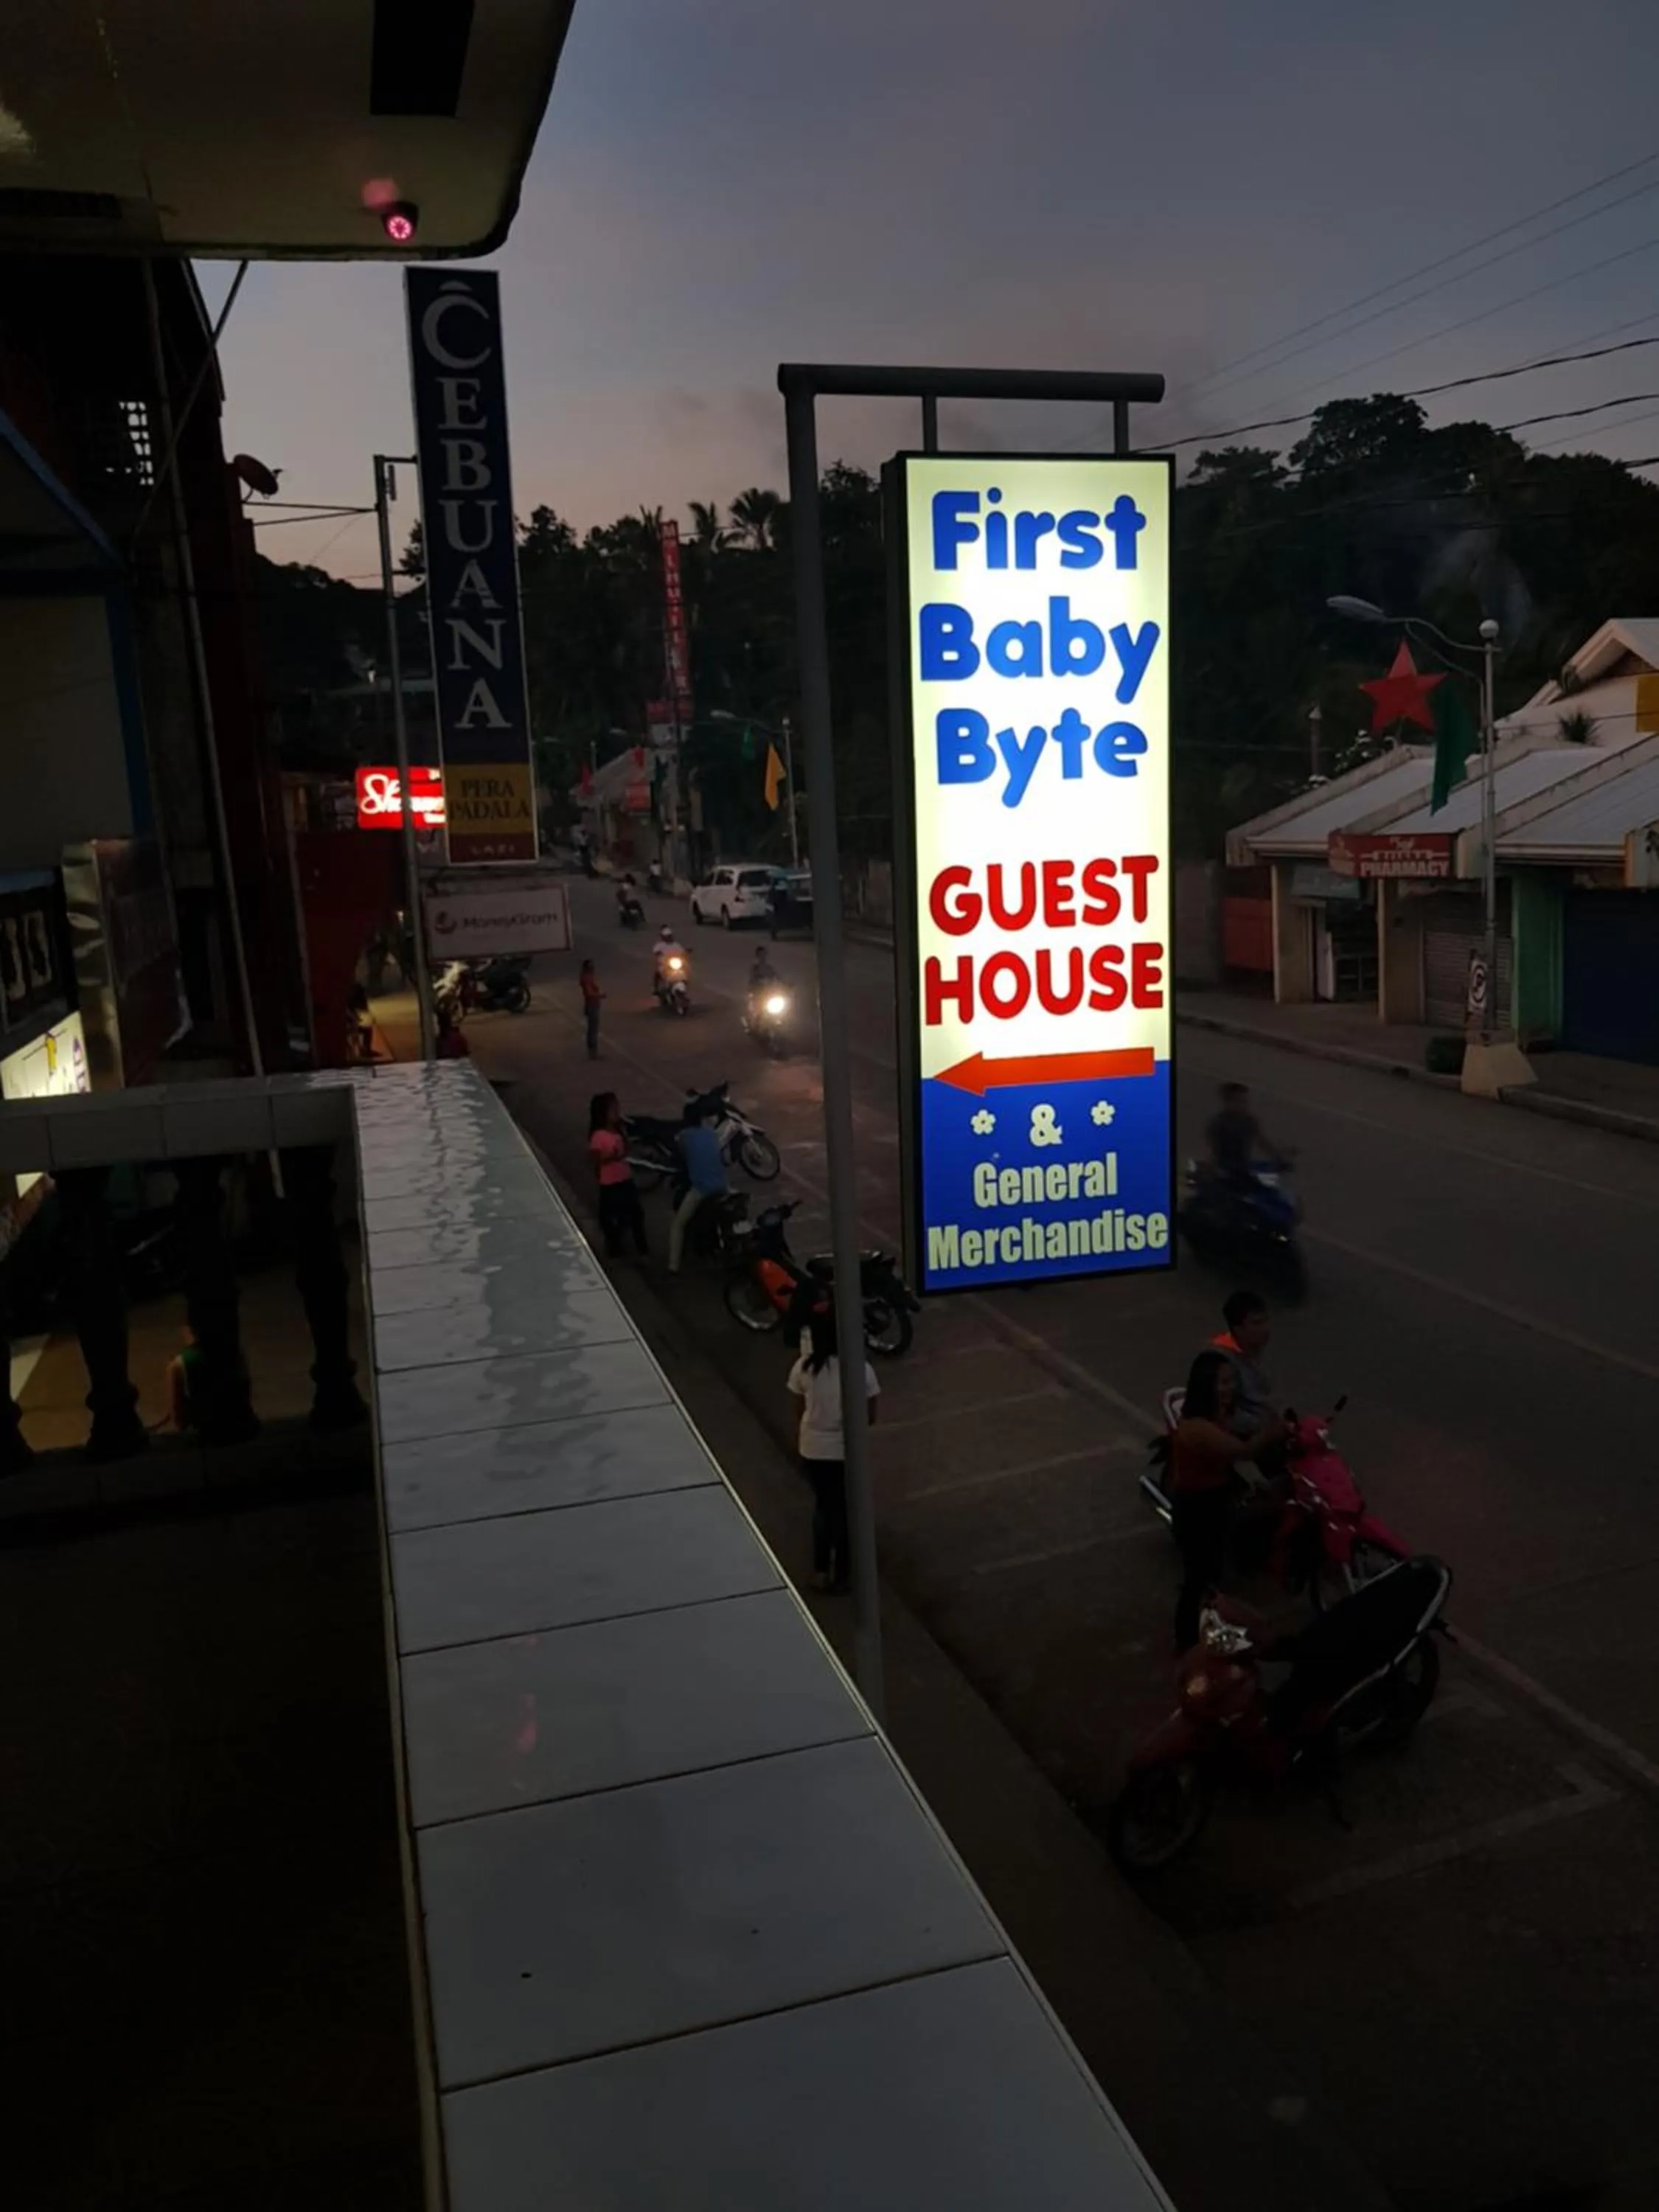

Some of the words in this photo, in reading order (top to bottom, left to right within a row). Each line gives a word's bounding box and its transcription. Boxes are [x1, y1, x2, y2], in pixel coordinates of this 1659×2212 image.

[421, 280, 513, 728] CEBUANA
[932, 487, 1146, 570] First
[919, 596, 1160, 704] Baby
[936, 708, 1148, 808] Byte
[448, 799, 530, 820] PADALA
[929, 855, 1159, 936] GUEST
[1360, 860, 1450, 877] PHARMACY
[925, 942, 1164, 1026] HOUSE
[1029, 1104, 1062, 1147] &
[973, 1152, 1117, 1208] General
[928, 1210, 1168, 1270] Merchandise
